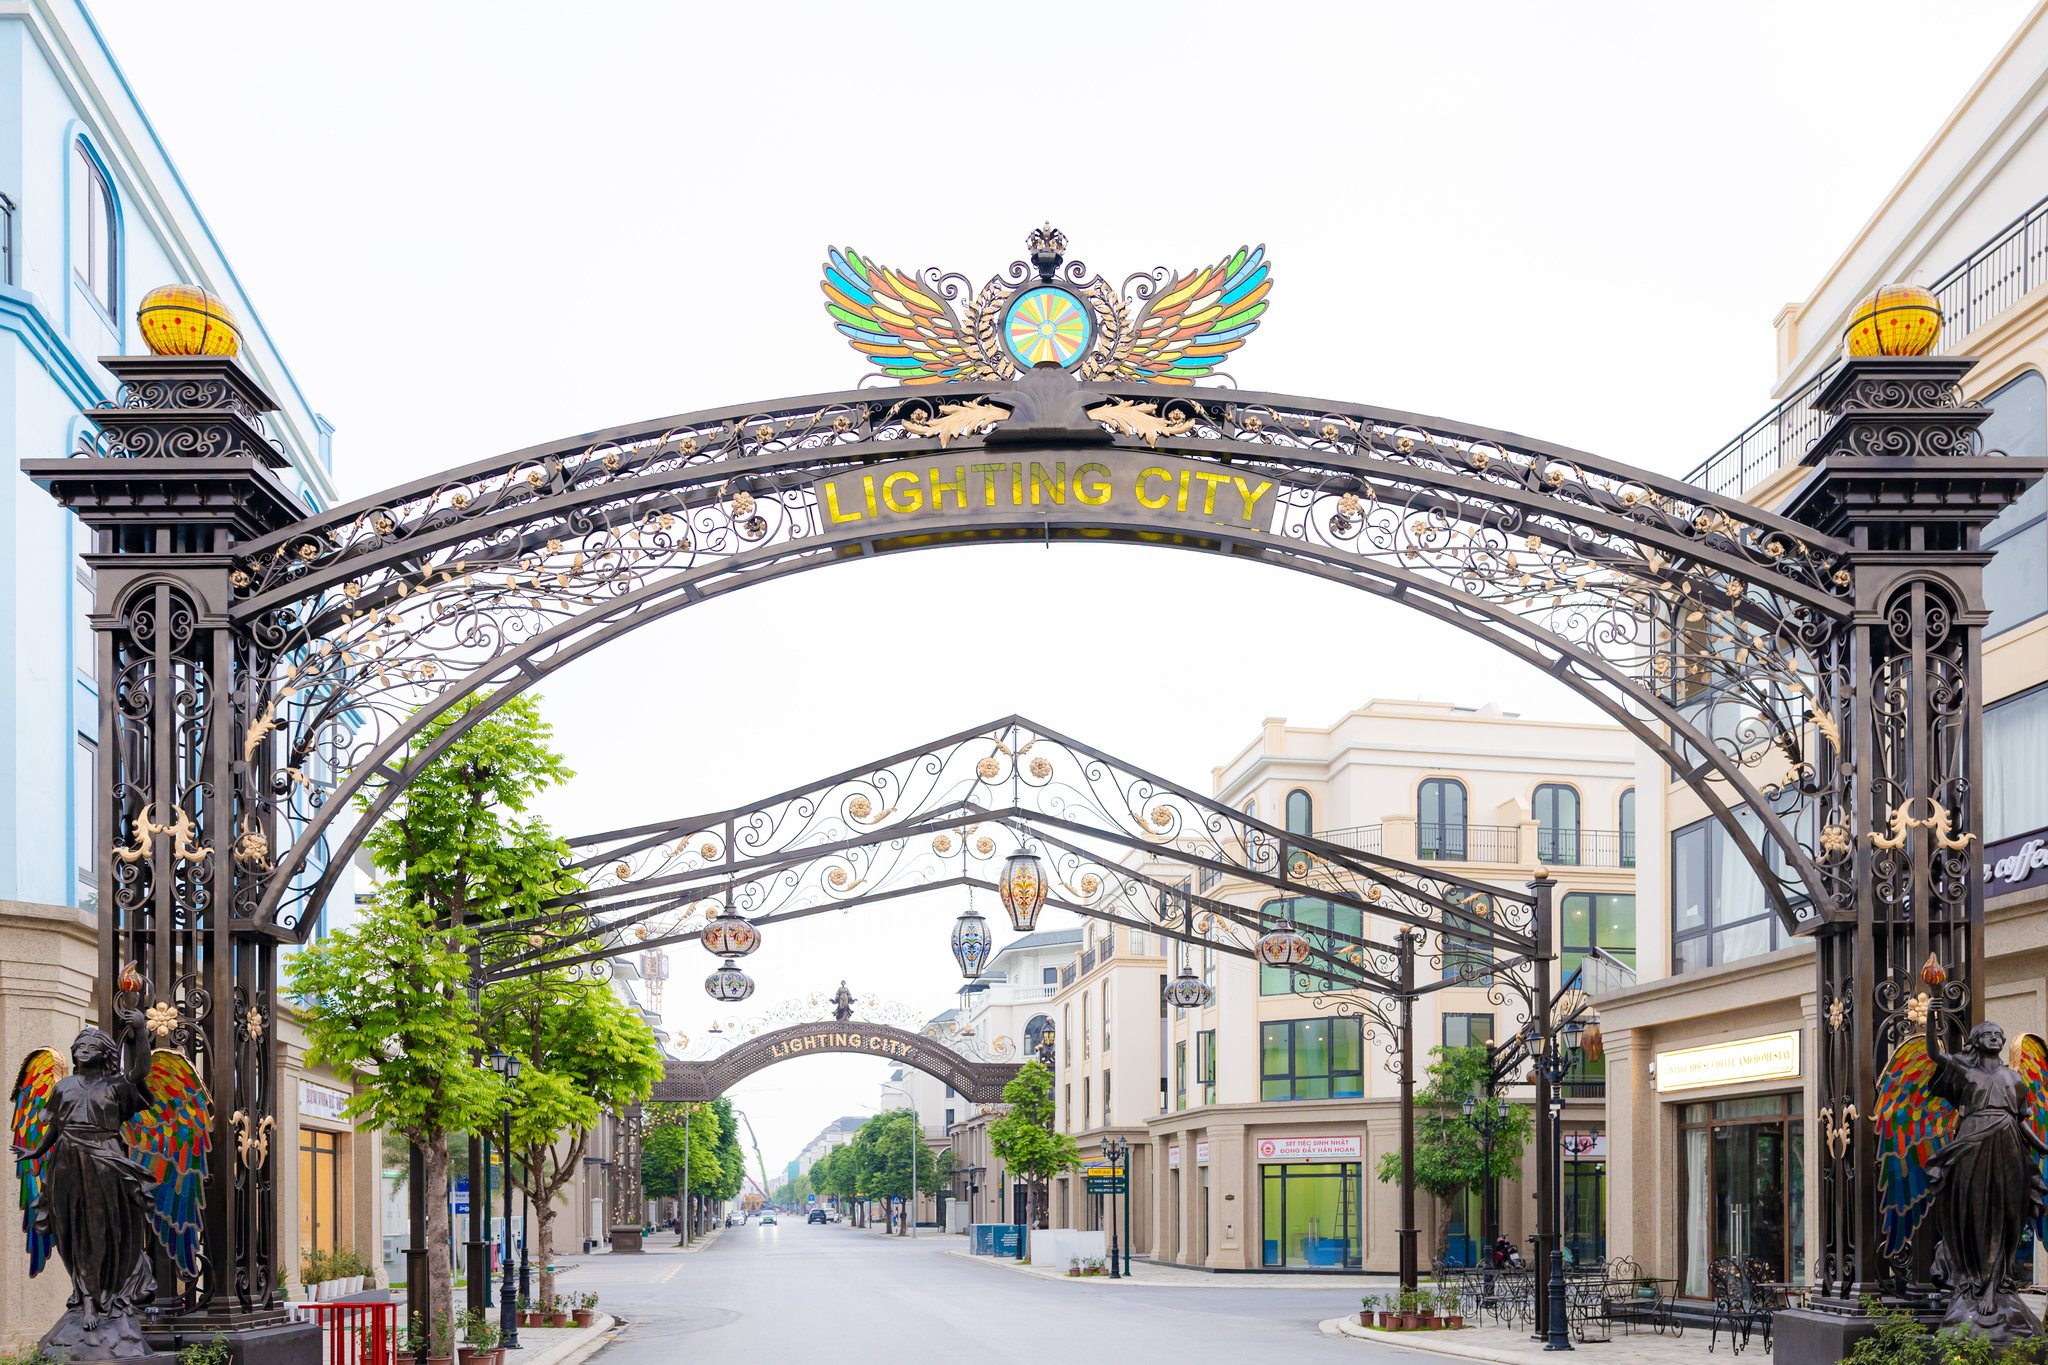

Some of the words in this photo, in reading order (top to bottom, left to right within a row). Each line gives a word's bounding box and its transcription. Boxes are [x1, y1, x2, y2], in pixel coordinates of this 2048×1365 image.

[825, 462, 1112, 525] LIGHTING
[1135, 466, 1273, 521] CITY
[1994, 839, 2048, 883] coffe
[771, 1033, 862, 1058] LIGHTING
[869, 1036, 913, 1057] CITY
[1753, 1049, 1790, 1063] HOMESTAY
